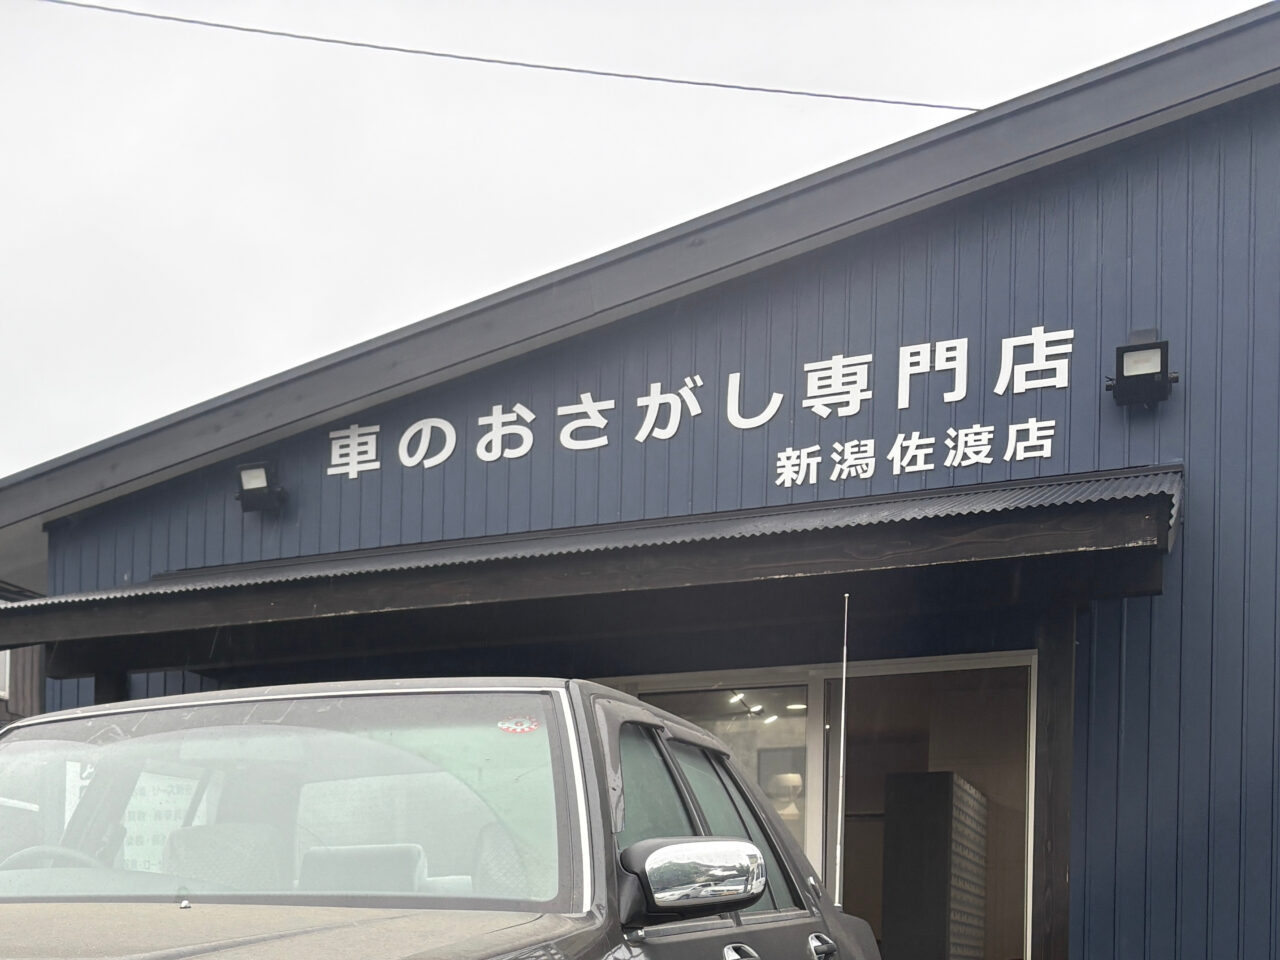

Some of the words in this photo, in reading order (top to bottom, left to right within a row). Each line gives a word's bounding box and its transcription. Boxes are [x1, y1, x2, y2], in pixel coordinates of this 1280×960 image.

[326, 325, 1075, 480] 車のおさがし専門店
[775, 418, 1057, 488] 新潟佐渡店
